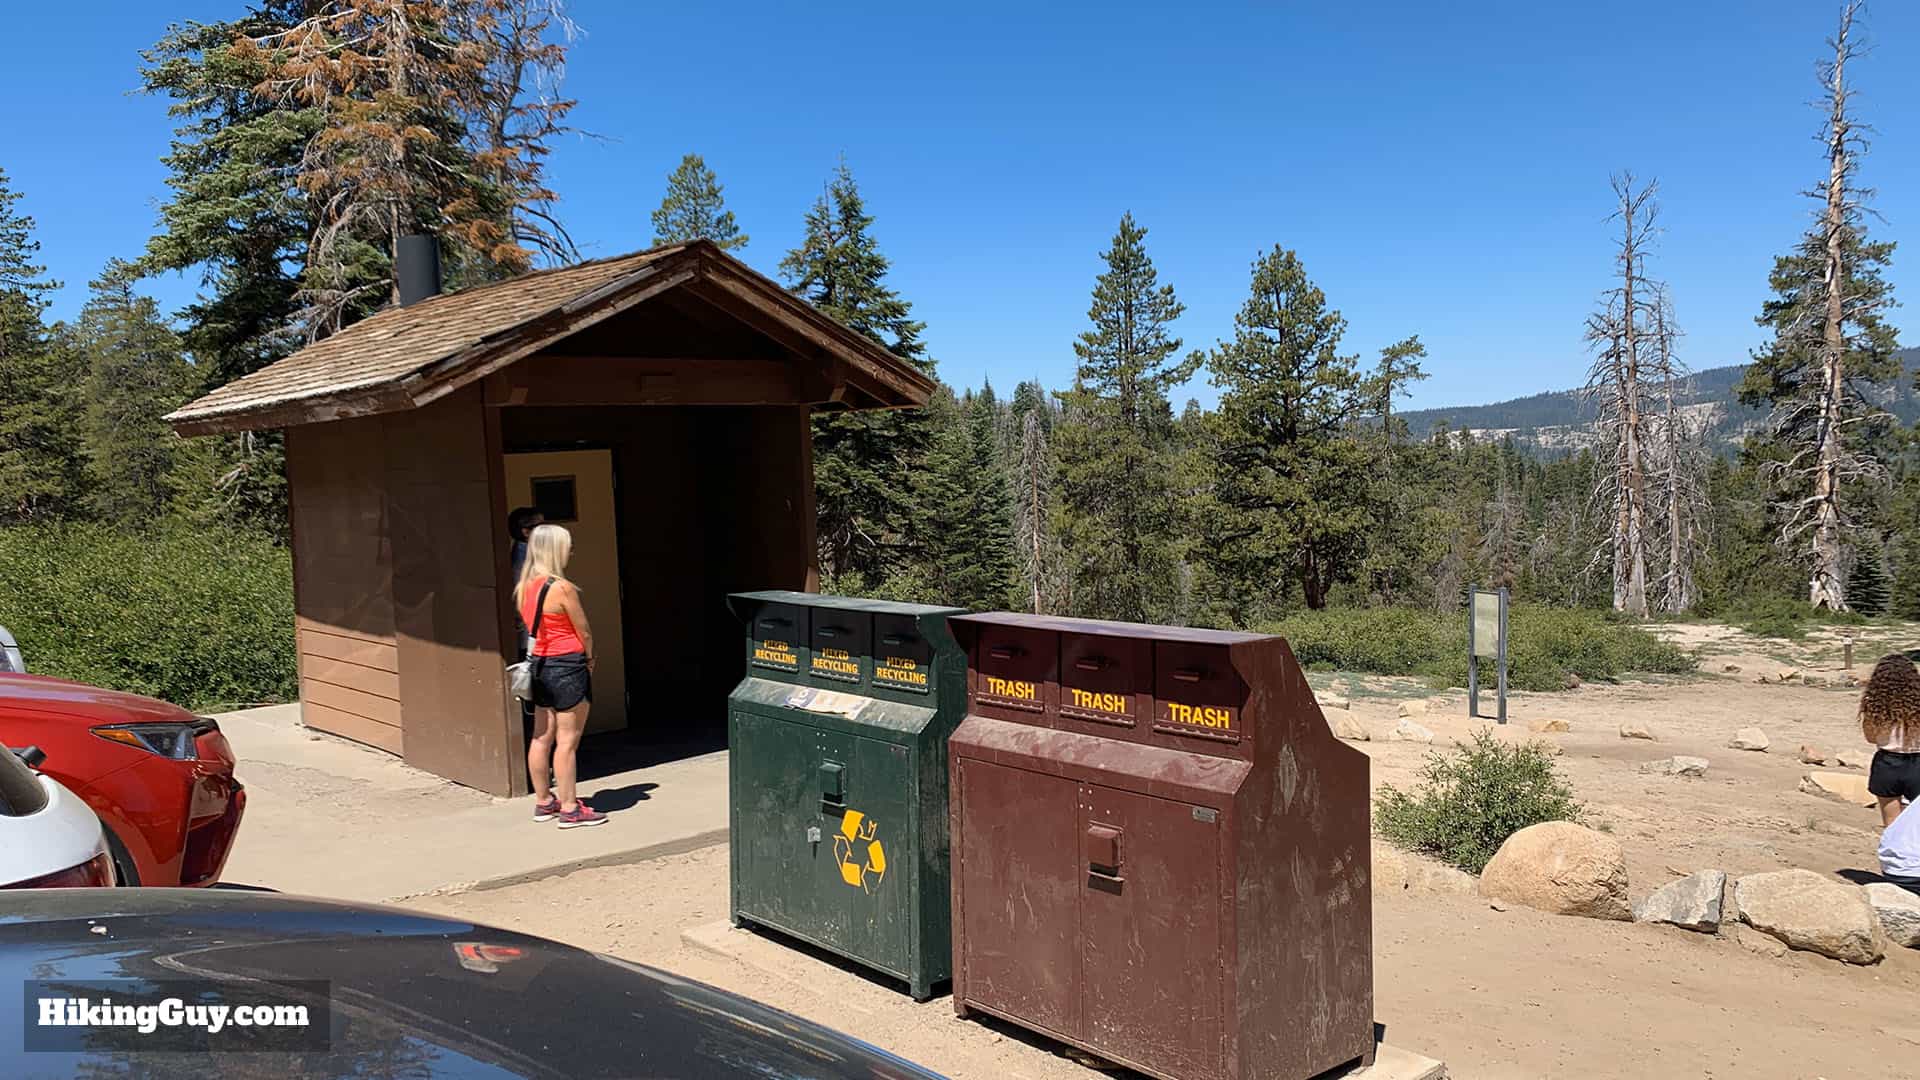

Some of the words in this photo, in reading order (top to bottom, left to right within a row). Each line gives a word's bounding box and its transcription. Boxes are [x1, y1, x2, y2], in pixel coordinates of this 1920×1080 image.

[755, 648, 797, 665] RECYCLING
[822, 647, 848, 661] MIXED
[813, 657, 859, 674] RECYCLING
[887, 656, 916, 670] MIXED
[876, 666, 927, 684] RECYCLING
[987, 677, 1035, 700] TRASH
[1071, 688, 1126, 714] TRASH
[1168, 702, 1230, 730] TRASH
